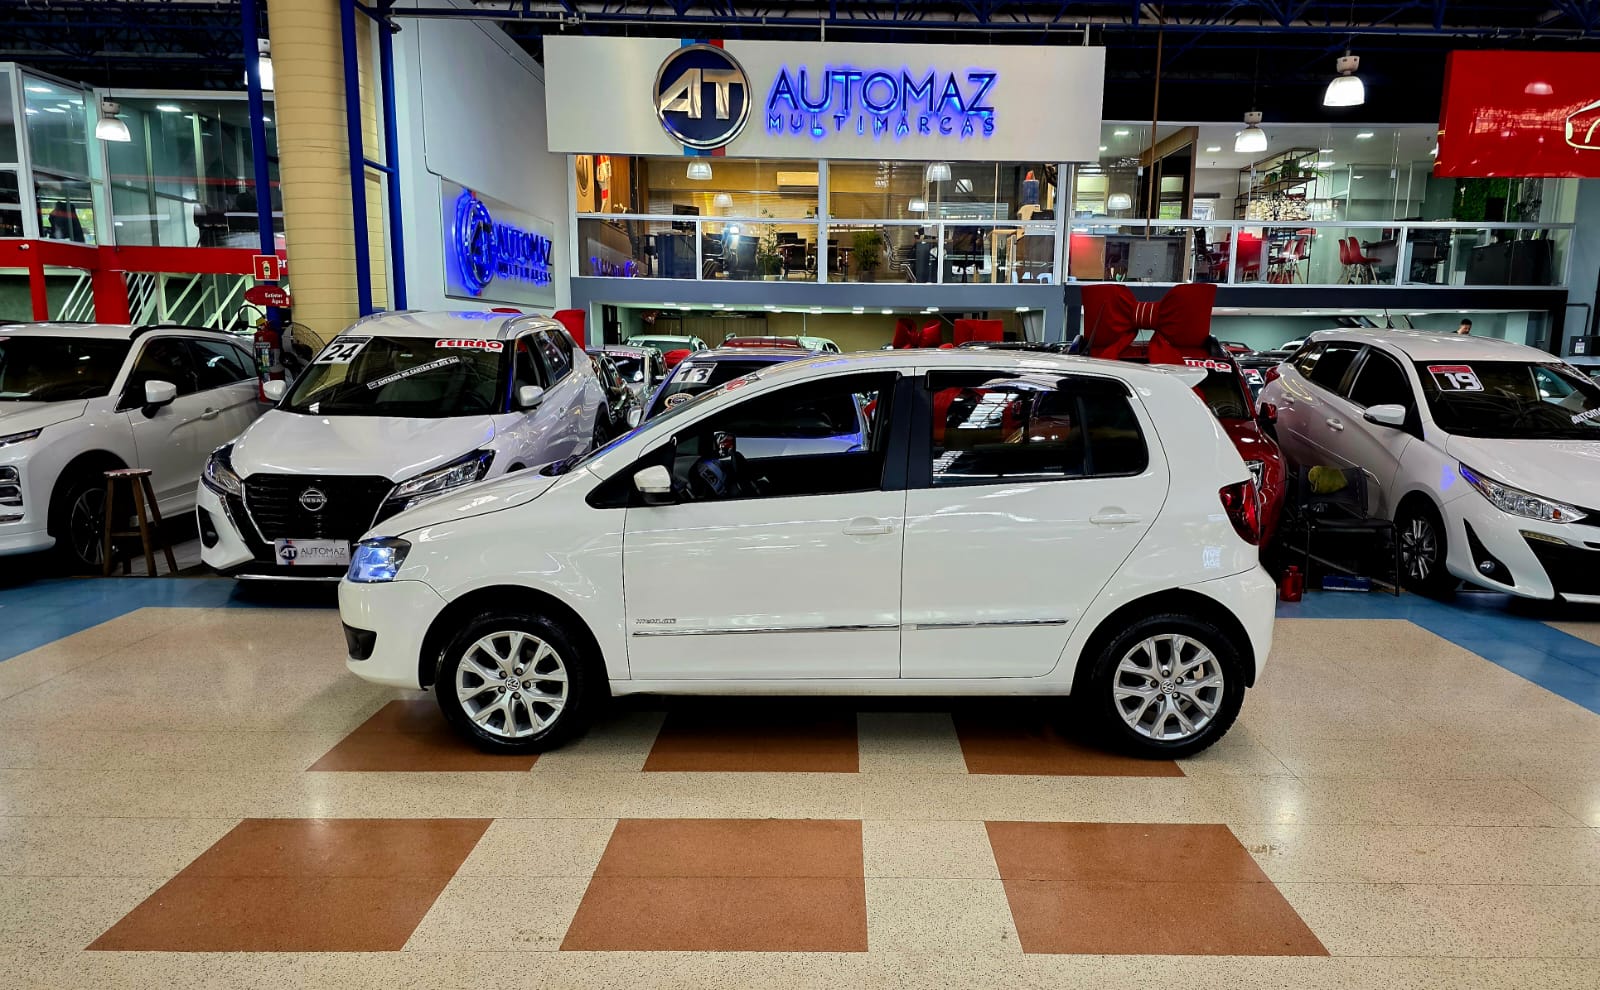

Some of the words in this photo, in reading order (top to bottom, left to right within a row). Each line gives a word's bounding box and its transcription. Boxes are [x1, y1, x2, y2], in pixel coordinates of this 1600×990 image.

[660, 69, 745, 119] AT
[768, 68, 997, 114] AUTOMAZ
[767, 114, 995, 135] MULTIMARCAS
[320, 344, 360, 361] 24
[436, 339, 503, 350] FEIRÃO
[681, 369, 709, 382] 13
[1444, 372, 1481, 391] 19
